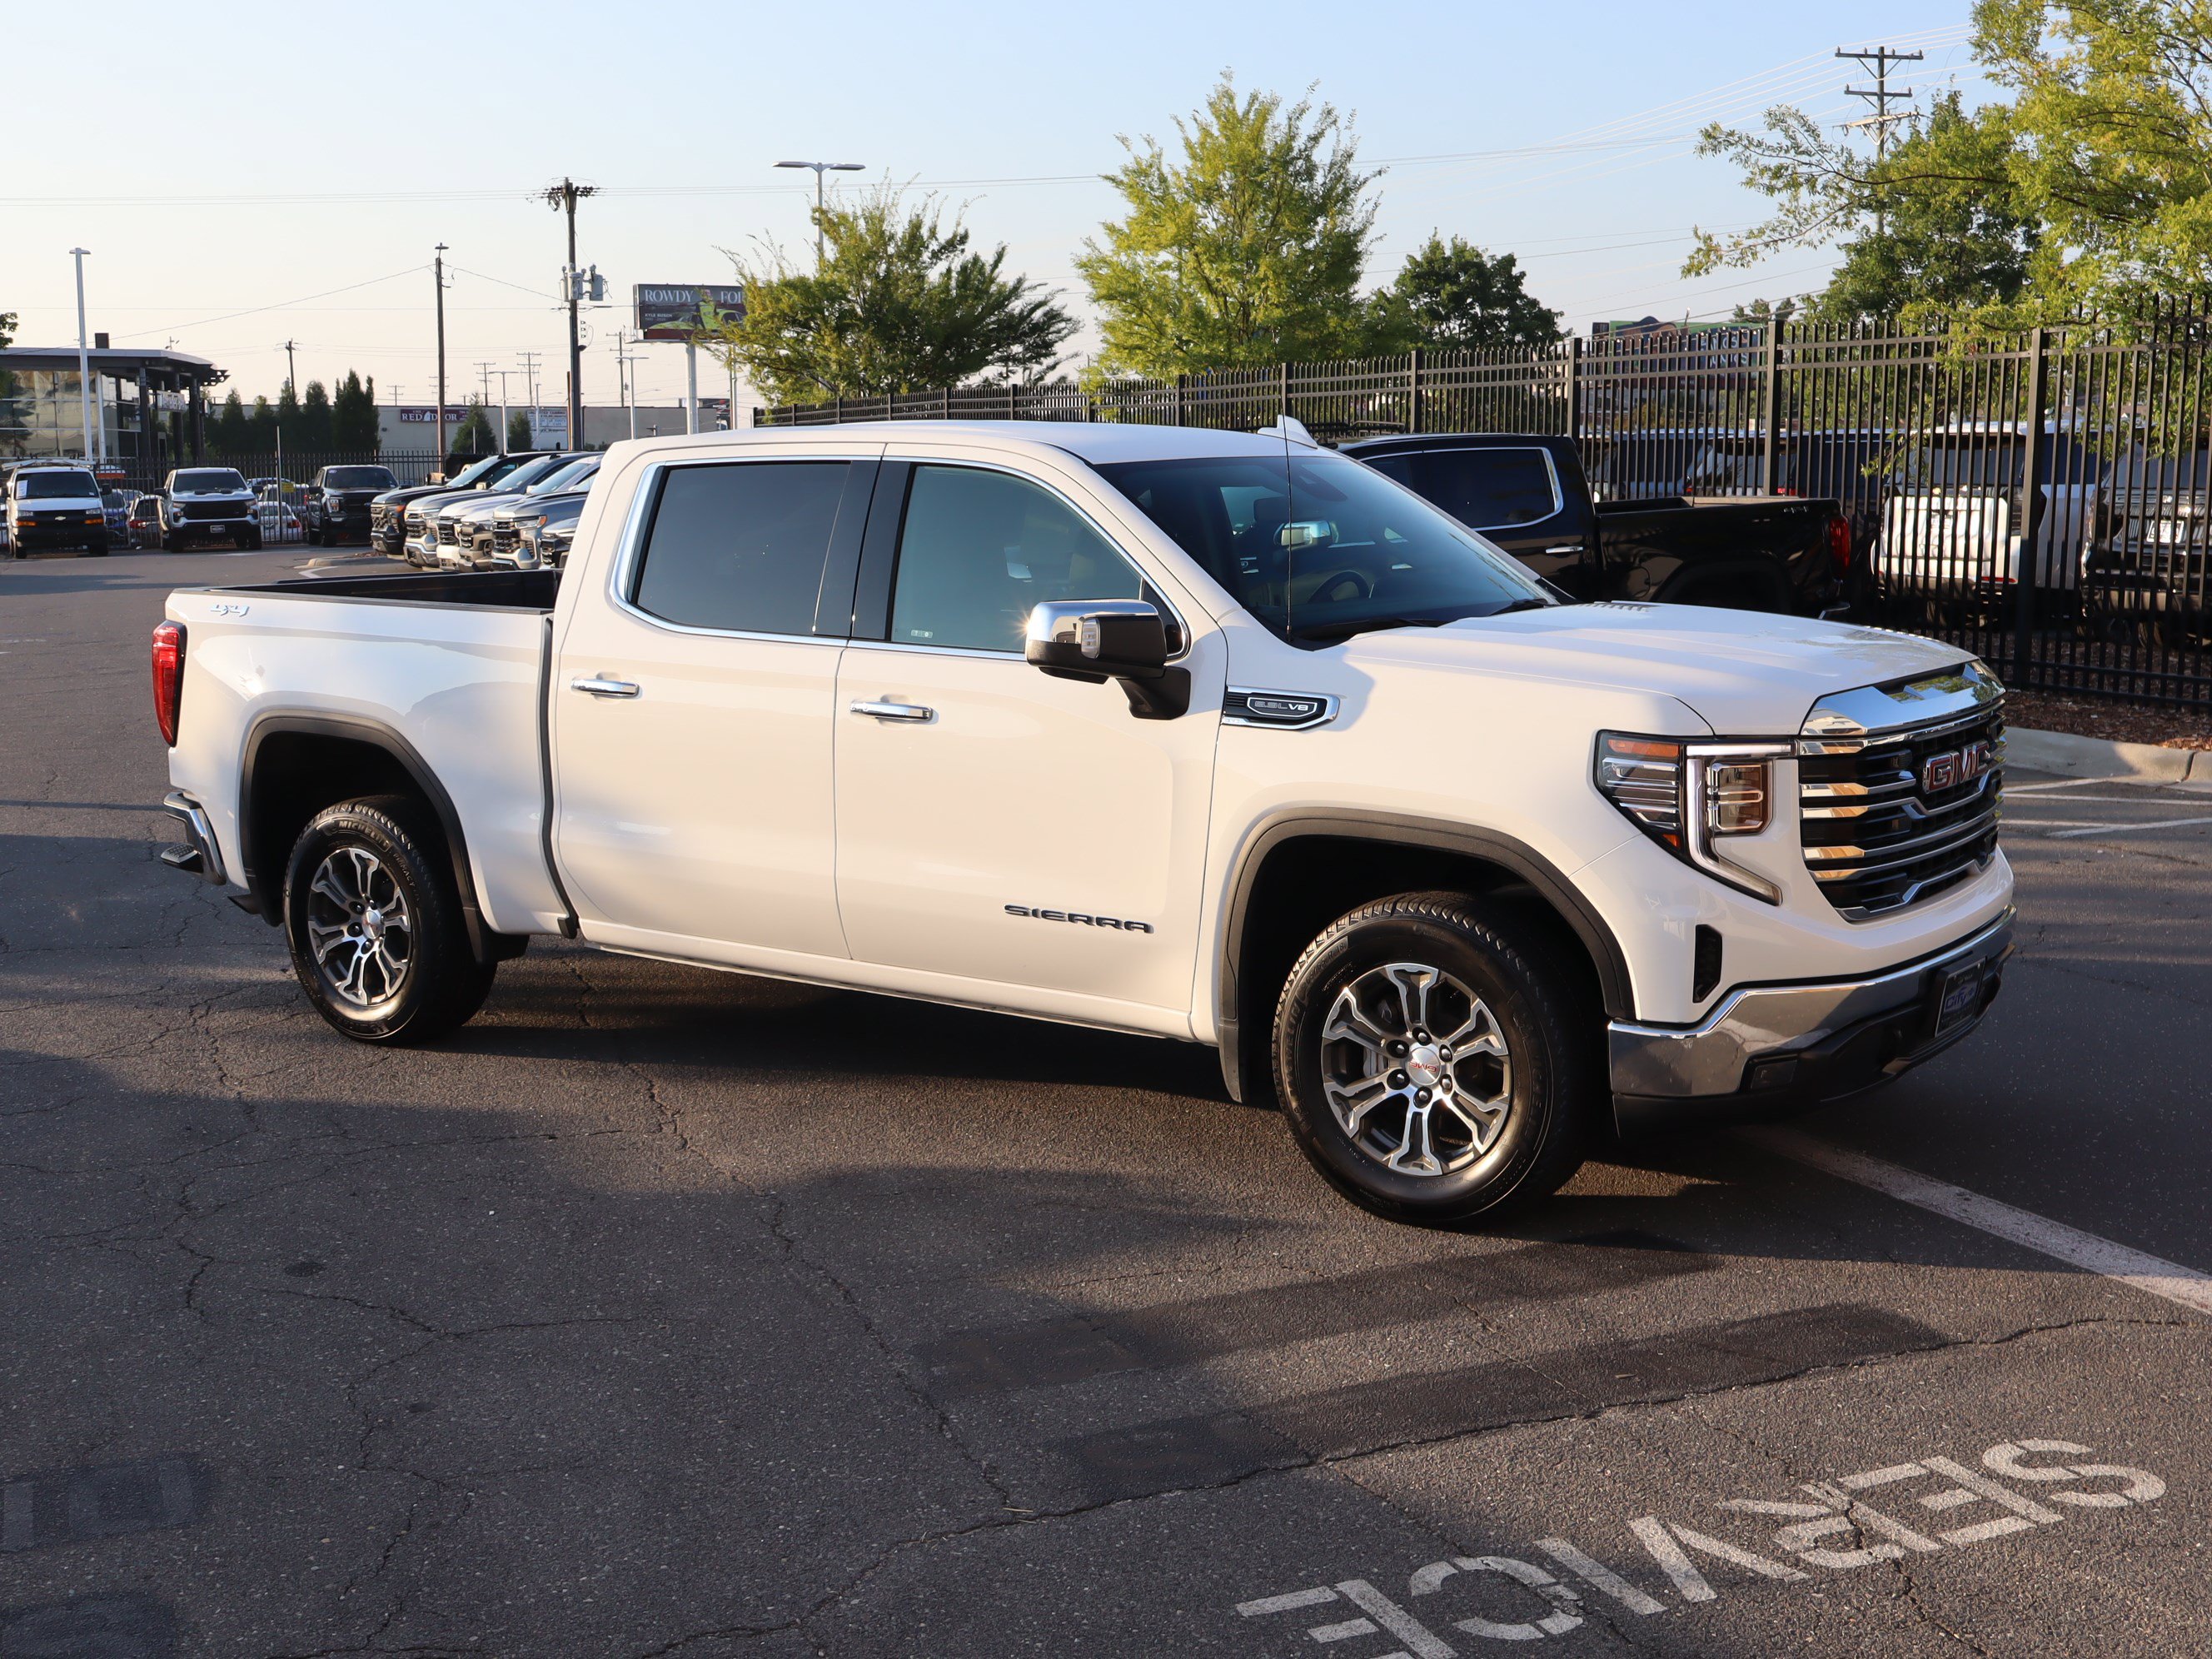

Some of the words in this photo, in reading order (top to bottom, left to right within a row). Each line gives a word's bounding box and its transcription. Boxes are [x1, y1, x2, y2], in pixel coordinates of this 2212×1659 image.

[645, 289, 694, 303] ROWDY
[401, 413, 423, 421] RED
[431, 413, 457, 421] DOR
[1288, 703, 1309, 711] V8
[1922, 740, 1991, 795] GMC
[1004, 904, 1155, 934] SIERRA
[1409, 1061, 1440, 1073] GMC
[1235, 1438, 2167, 1659] SERVICE
